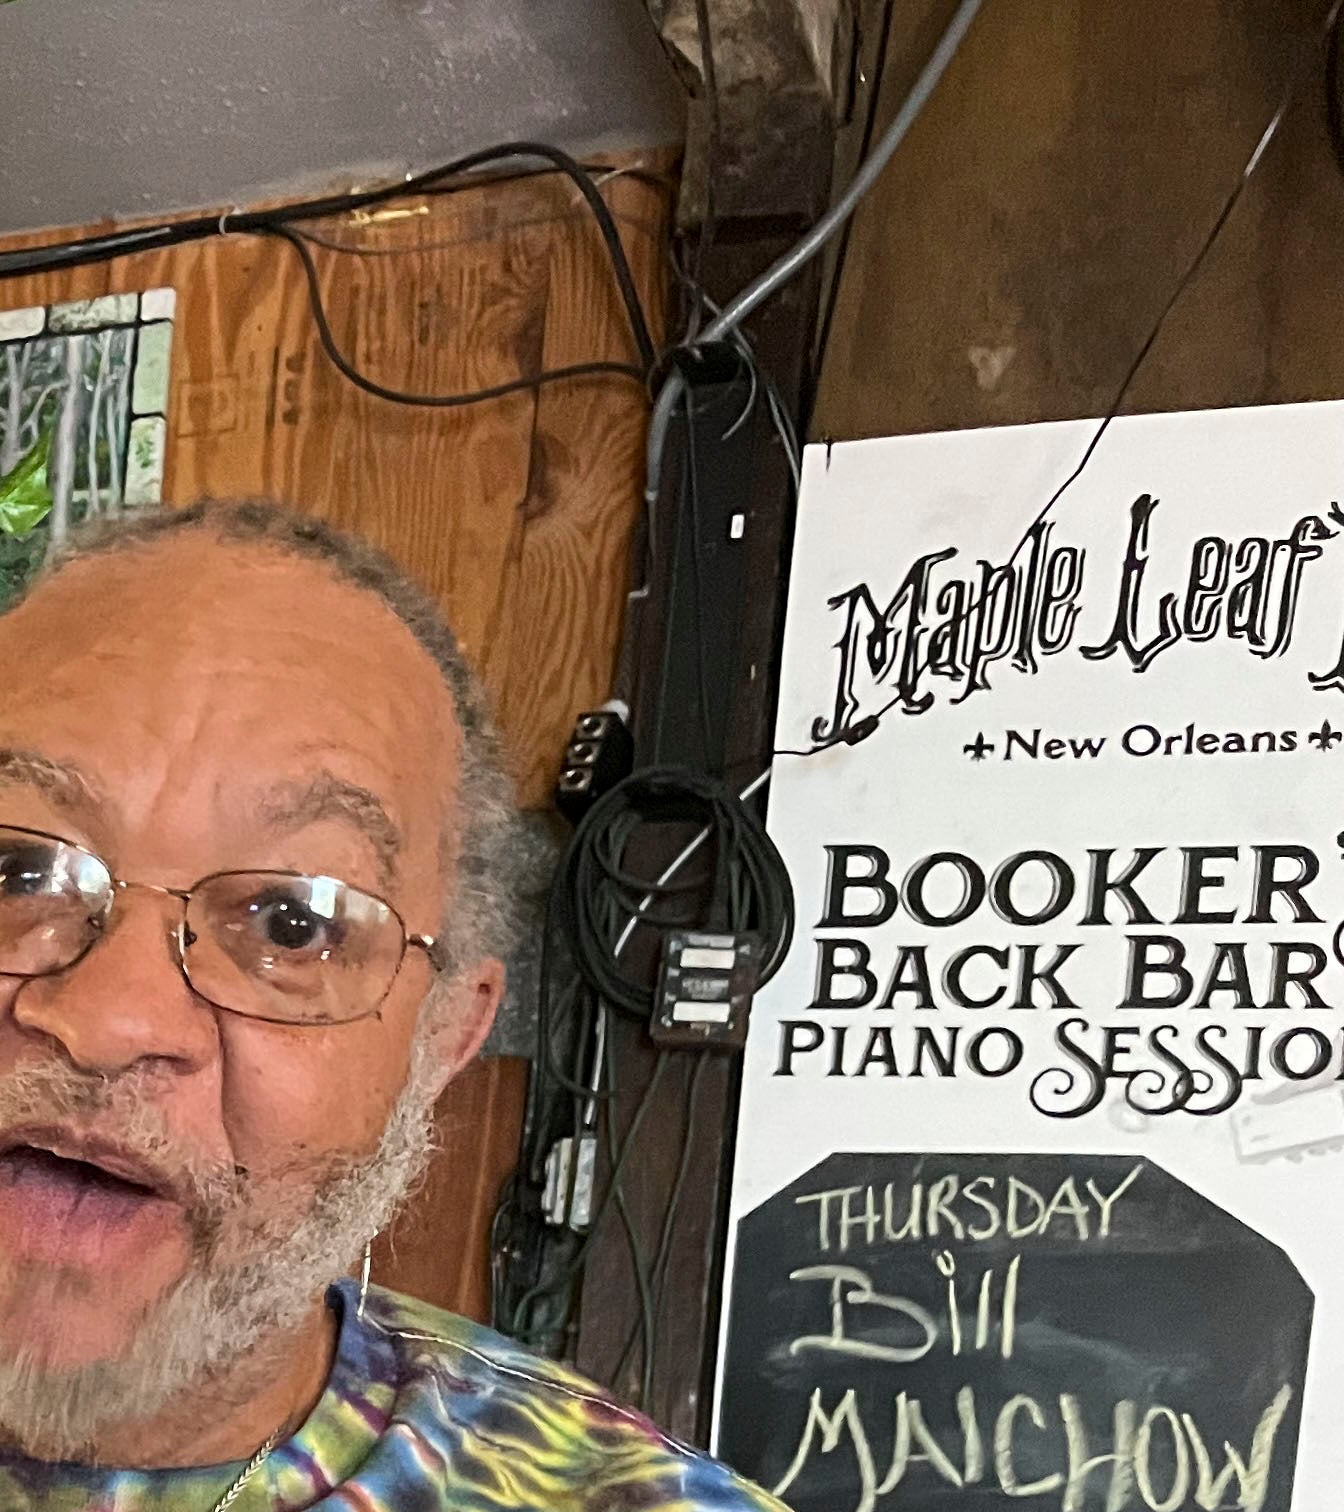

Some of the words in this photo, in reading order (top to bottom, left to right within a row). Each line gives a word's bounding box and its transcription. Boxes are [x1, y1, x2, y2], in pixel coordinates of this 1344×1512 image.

[812, 518, 1085, 743] Maple
[1080, 494, 1340, 674] Leaf
[1003, 728, 1103, 762] New
[1121, 723, 1299, 758] Orleans
[813, 843, 1326, 928] BOOKER
[811, 936, 1084, 1010] BACK
[1116, 934, 1333, 1010] BAR
[772, 1019, 1023, 1078] PIANO
[1029, 1017, 1344, 1118] SESSIO
[795, 1163, 1143, 1252] THURSDAY
[789, 1249, 1019, 1361] Bill
